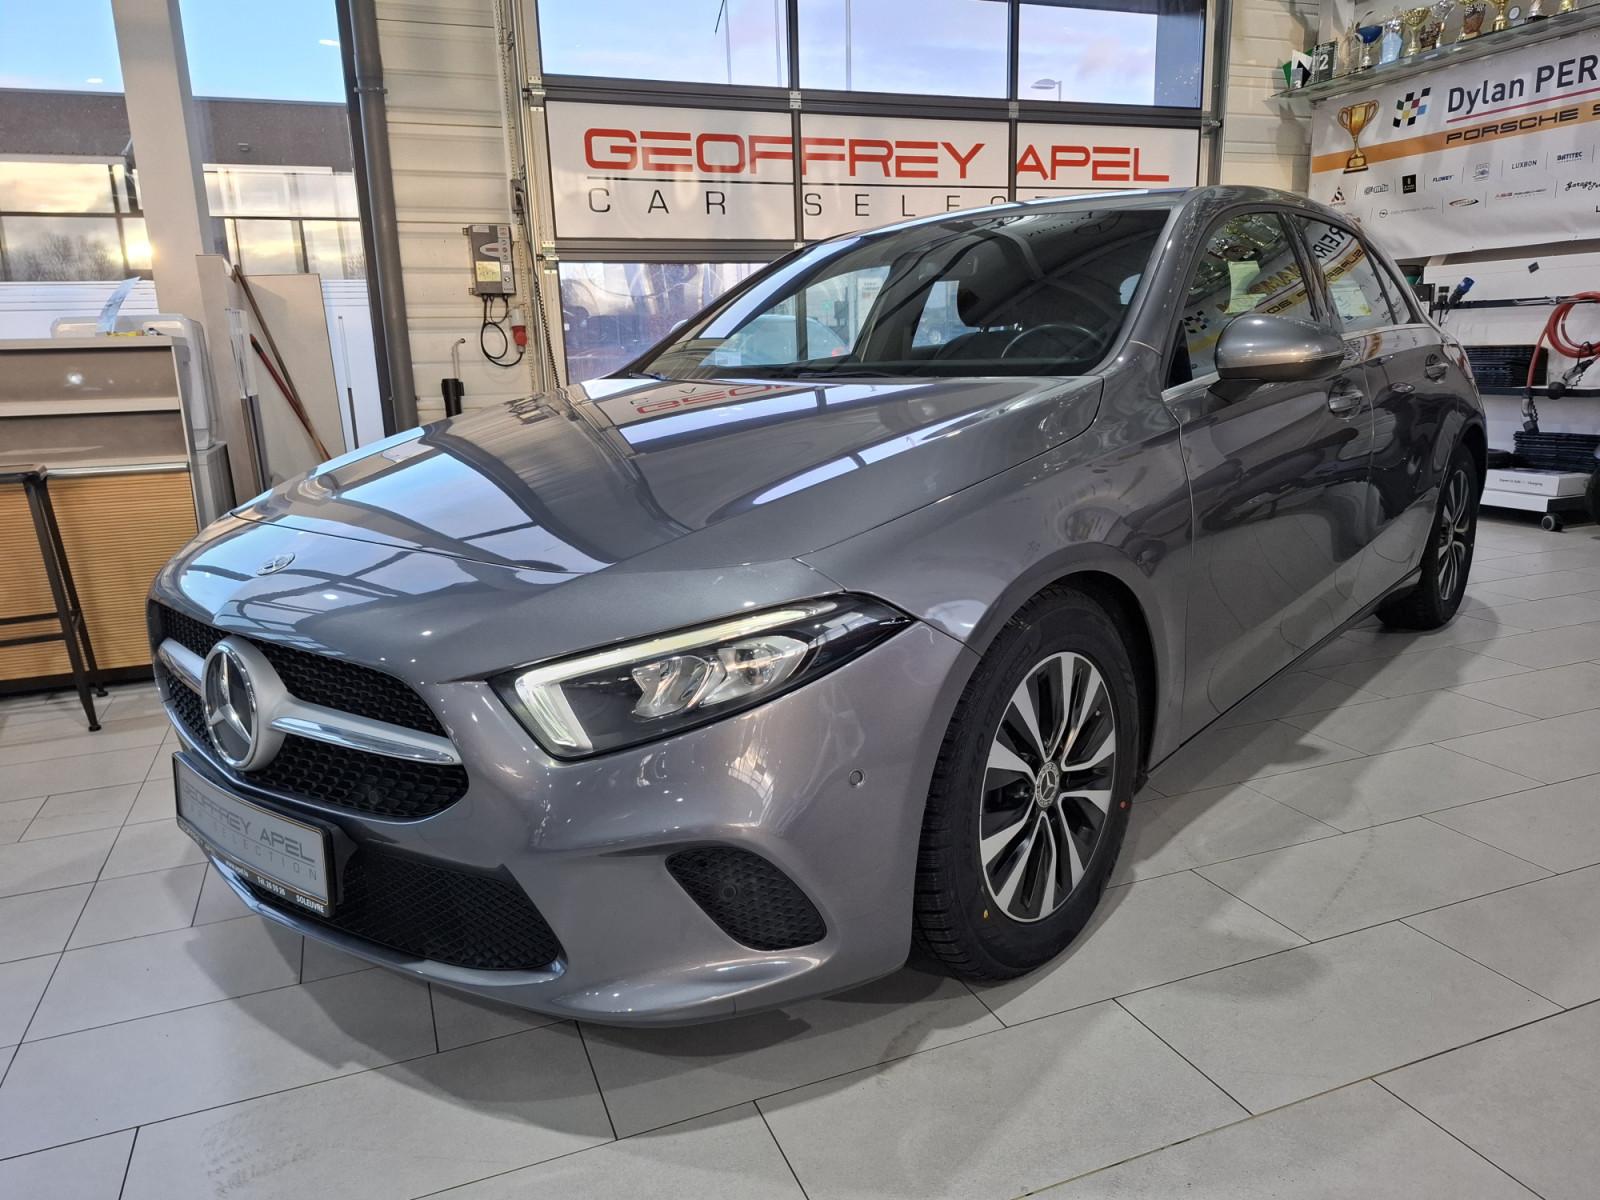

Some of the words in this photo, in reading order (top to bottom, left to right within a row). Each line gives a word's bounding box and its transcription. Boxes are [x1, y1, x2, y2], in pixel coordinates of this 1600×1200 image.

[1319, 54, 1329, 70] 2
[1447, 78, 1525, 114] Dylan
[1536, 54, 1599, 93] PER
[1446, 108, 1579, 144] PORSCHE
[583, 127, 985, 181] GEOFFREY
[1016, 143, 1170, 183] APEL
[588, 187, 726, 215] CAR
[260, 828, 316, 863] APEL
[296, 894, 325, 914] SOLEUVRE
